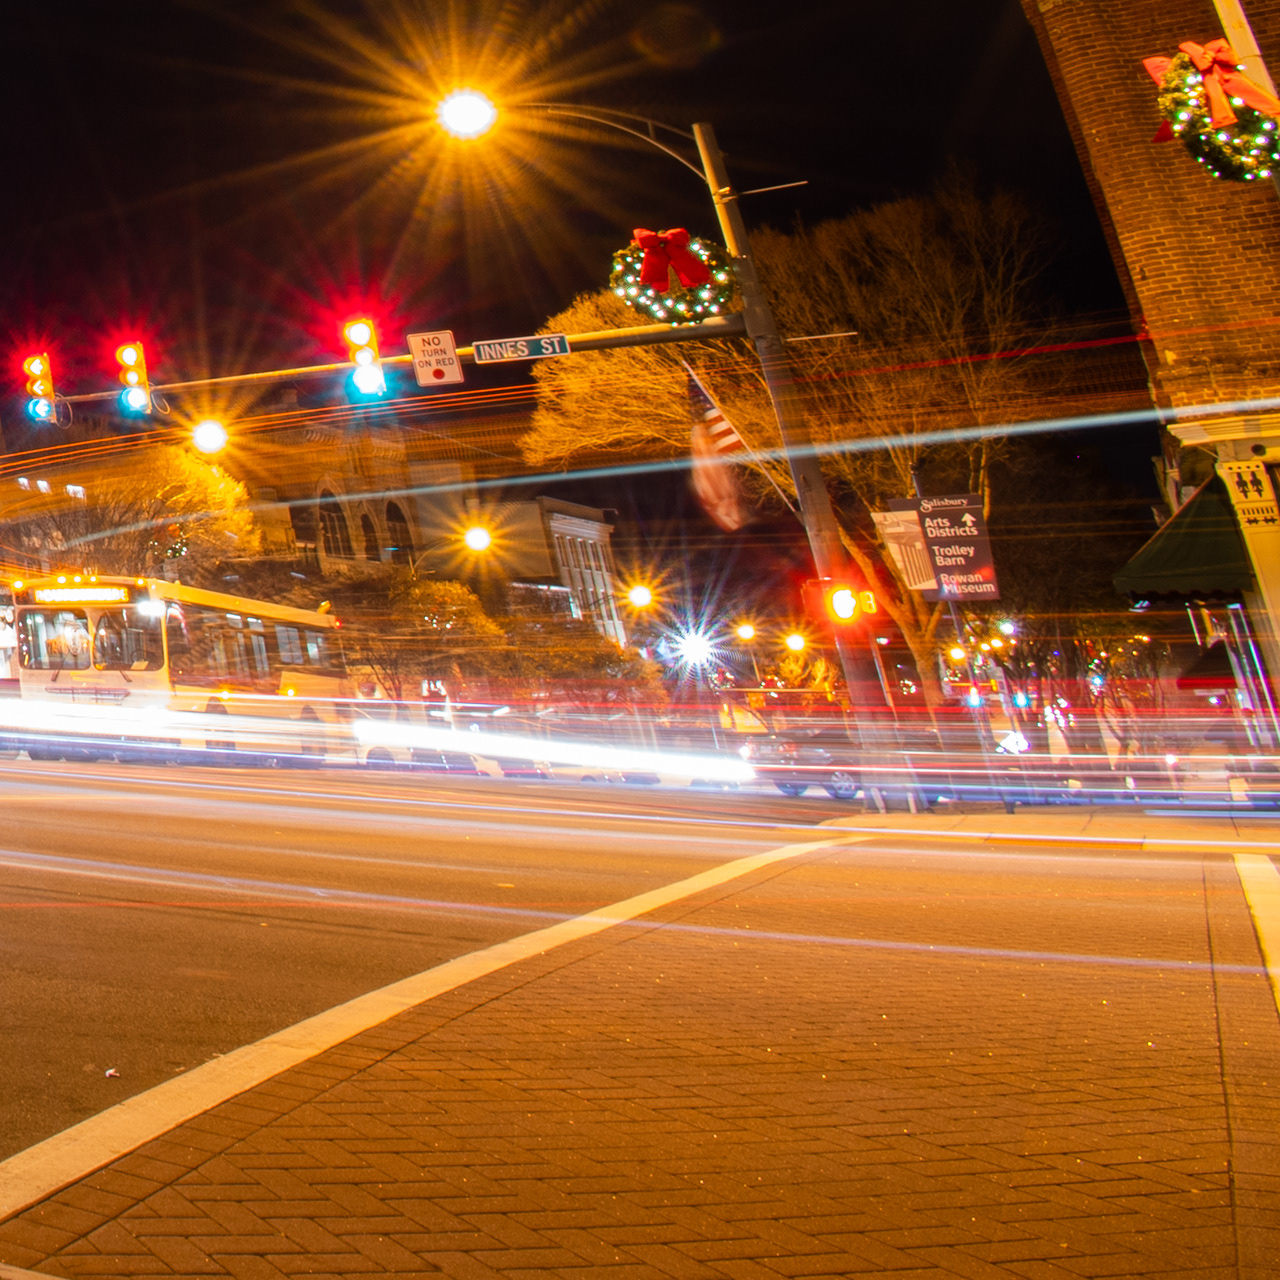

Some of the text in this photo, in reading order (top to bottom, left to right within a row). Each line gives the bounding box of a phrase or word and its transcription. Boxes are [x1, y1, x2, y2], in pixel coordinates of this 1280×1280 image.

[421, 336, 441, 347] NO
[421, 348, 447, 358] TURN
[479, 337, 561, 360] INNES ST
[418, 357, 455, 369] ON RED
[920, 498, 968, 513] Salisbury
[924, 517, 951, 528] Arts
[926, 526, 979, 538] Districts
[931, 545, 976, 557] Trolley
[935, 556, 966, 567] Barn
[940, 573, 984, 583] Rowan
[942, 583, 996, 594] Museum
